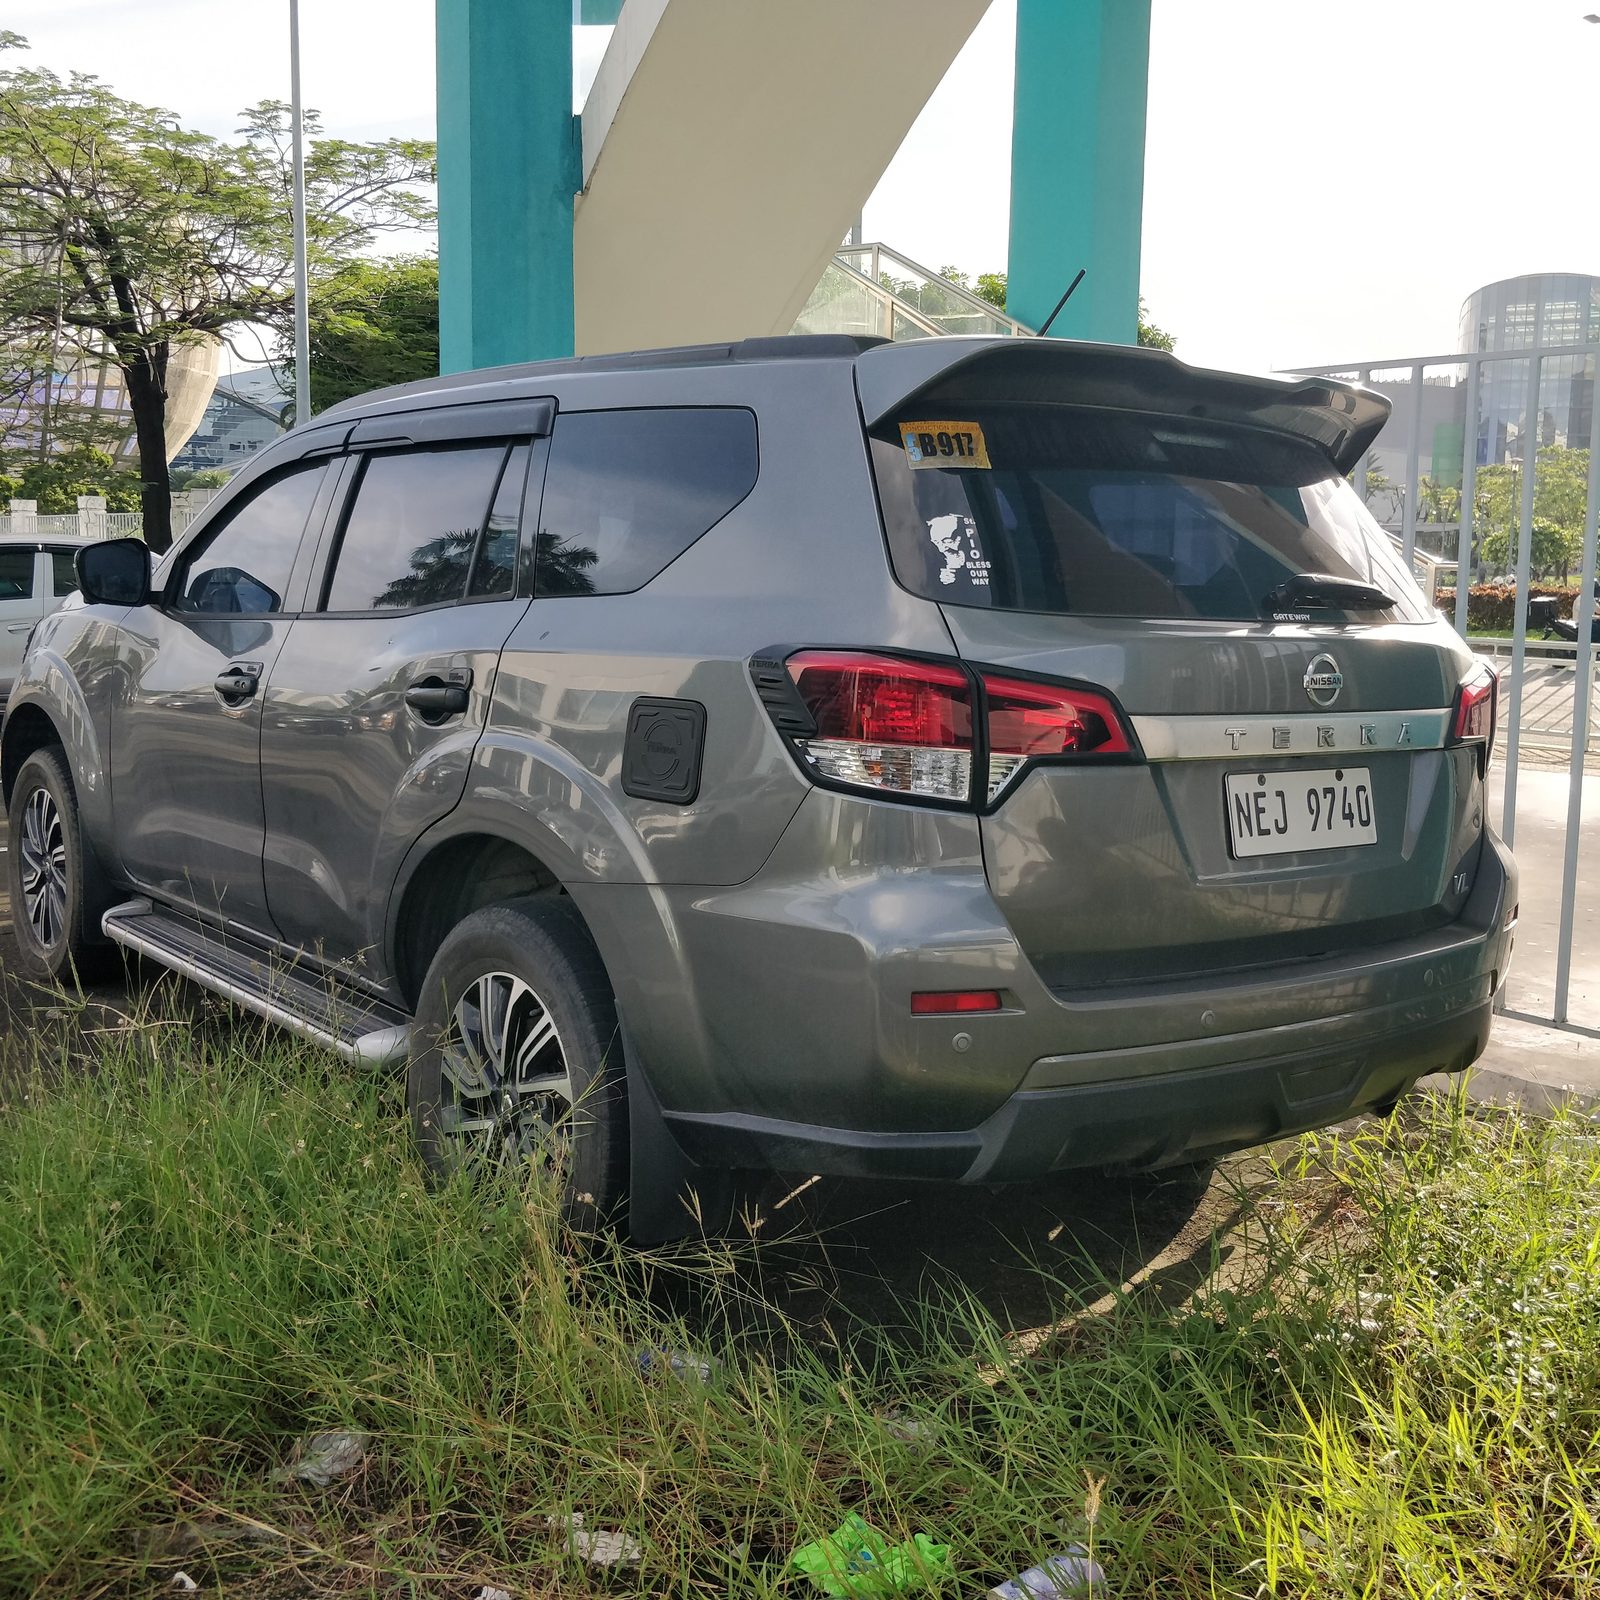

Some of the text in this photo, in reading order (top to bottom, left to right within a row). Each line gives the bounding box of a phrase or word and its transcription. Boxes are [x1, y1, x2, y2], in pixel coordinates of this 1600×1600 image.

[965, 561, 991, 569] BLESS
[970, 570, 989, 578] OUR
[971, 578, 990, 586] WAY
[751, 659, 780, 670] TERRA
[1310, 677, 1342, 686] NISSAN
[1224, 722, 1411, 750] TERRA
[1234, 785, 1371, 838] NEJ 9740
